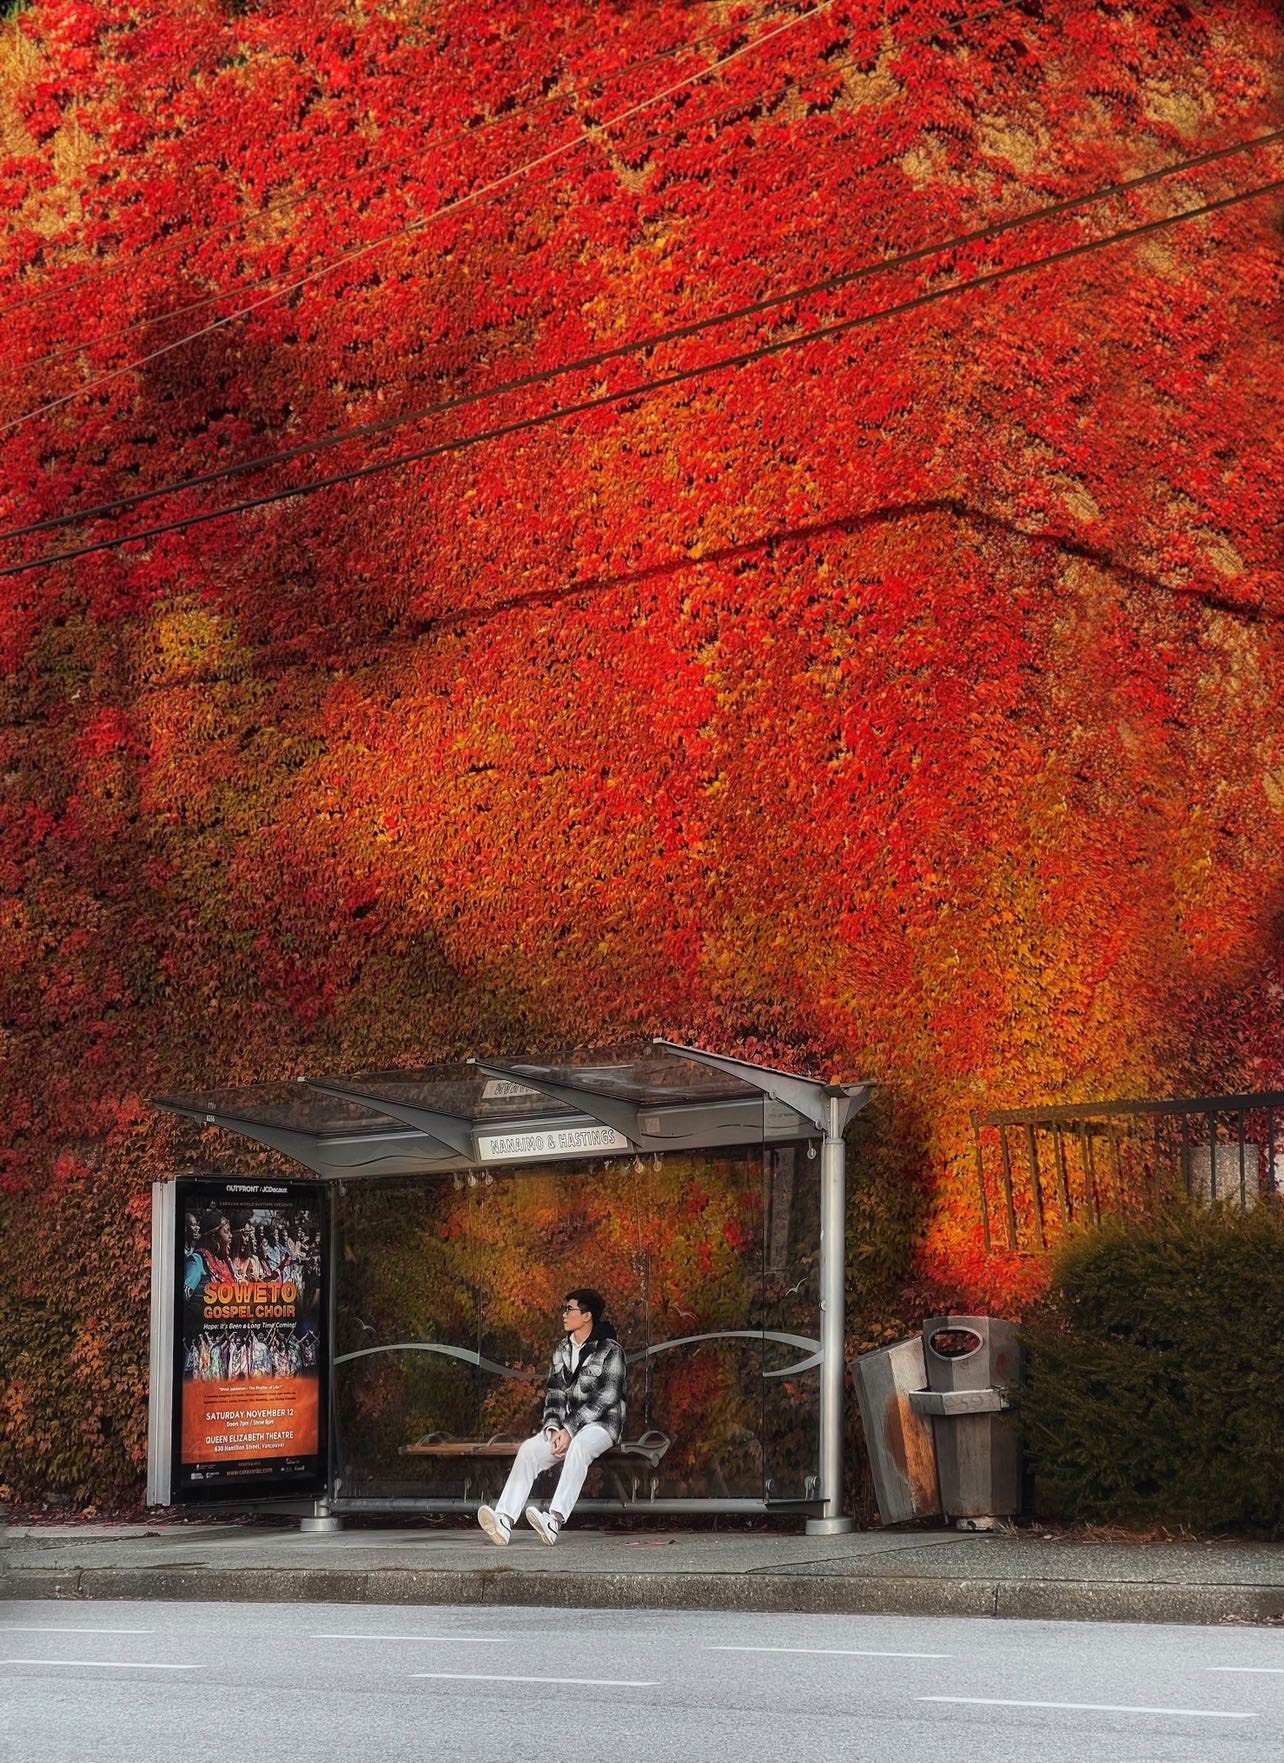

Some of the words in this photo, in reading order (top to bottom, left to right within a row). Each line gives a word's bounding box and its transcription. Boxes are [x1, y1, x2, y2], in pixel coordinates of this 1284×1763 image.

[490, 1135, 544, 1155] NANAIMO
[547, 1135, 556, 1149] &
[559, 1129, 616, 1149] HASTINGS
[226, 1184, 260, 1192] OUTFRONT
[203, 1281, 298, 1304] SOWETO
[203, 1305, 254, 1319] GOSPEL
[255, 1304, 296, 1318] CHOIR
[247, 1322, 260, 1330] Long
[275, 1321, 297, 1329] Coming!
[205, 1411, 245, 1420] SATURDAY
[246, 1408, 286, 1418] NOVEMBER
[287, 1408, 294, 1416] 12
[205, 1435, 228, 1444] QUEEN
[229, 1432, 265, 1443] ELIZABETH
[266, 1431, 294, 1440] THEATRE
